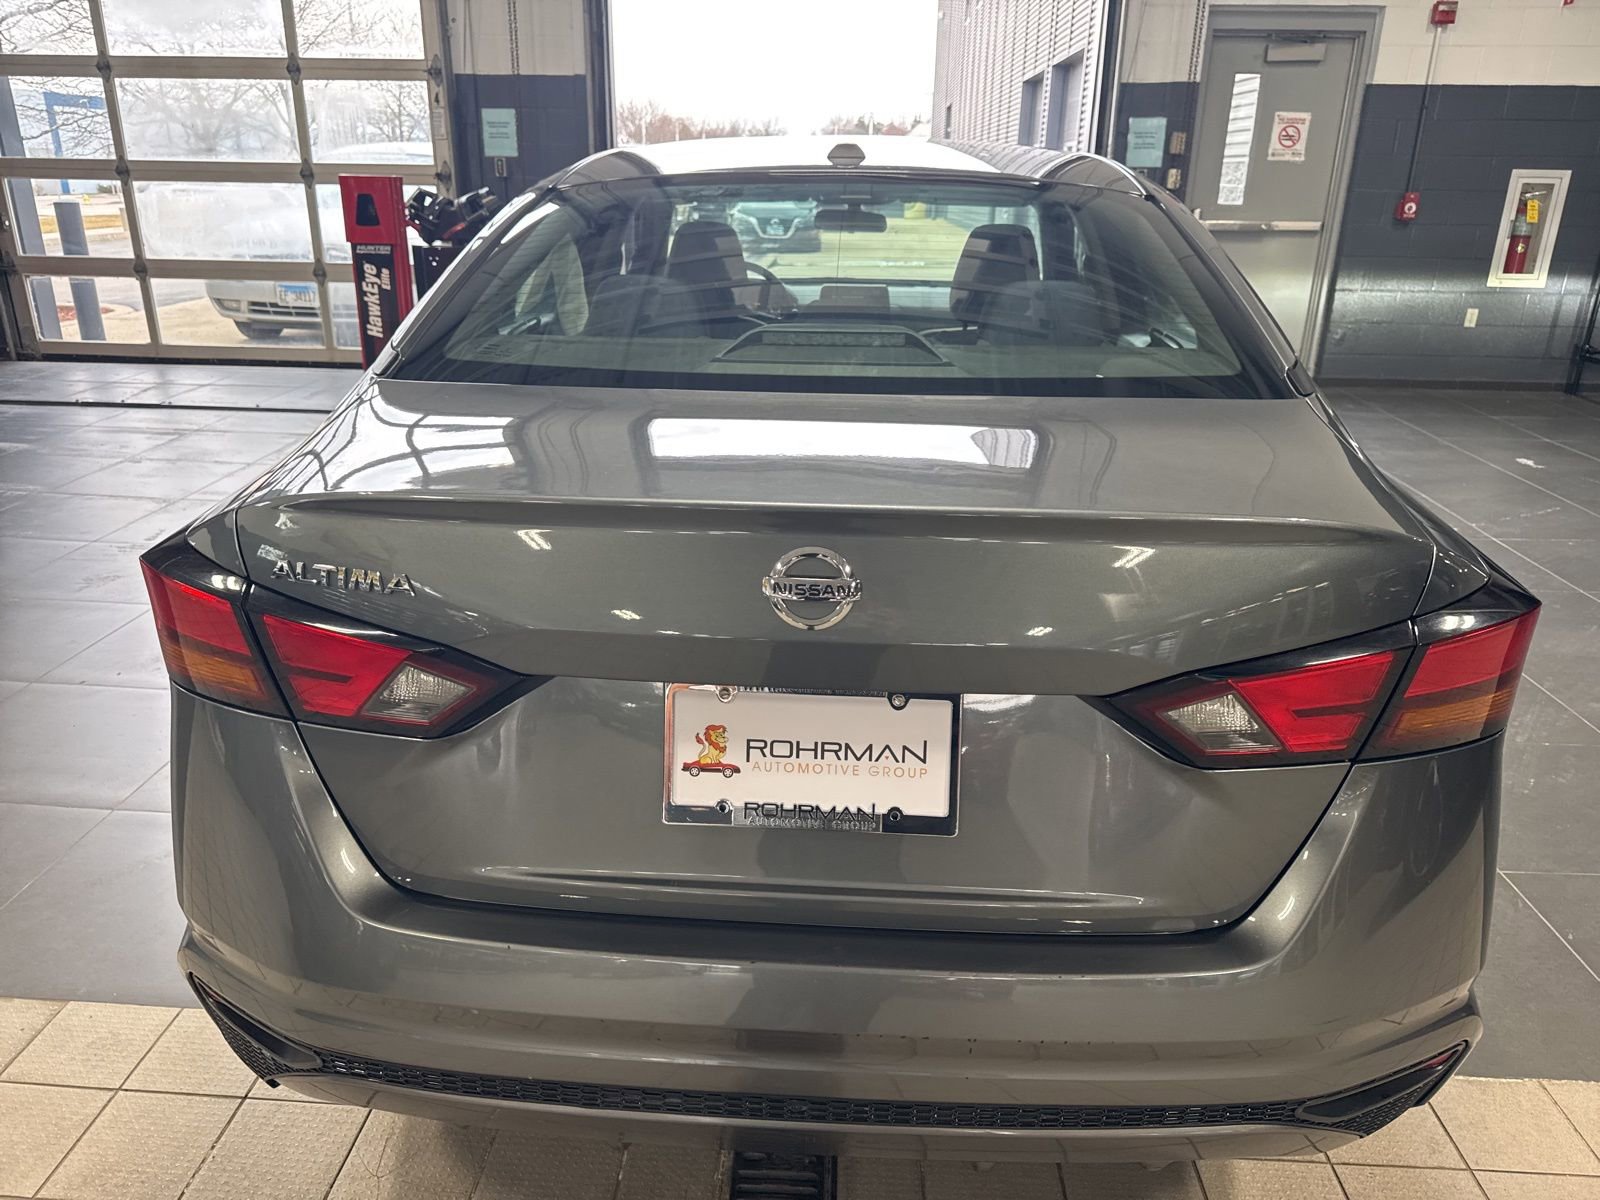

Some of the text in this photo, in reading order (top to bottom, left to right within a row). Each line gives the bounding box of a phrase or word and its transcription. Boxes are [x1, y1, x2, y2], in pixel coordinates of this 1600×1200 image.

[381, 267, 391, 291] Elite
[362, 263, 384, 339] HawkEye
[270, 559, 416, 597] ALTIMA
[773, 581, 852, 598] NISSAN
[746, 738, 928, 765] ROHRMAN
[751, 761, 928, 779] AUTOMOTIVE GROUP
[744, 802, 876, 821] ROHRMAN
[831, 820, 876, 832] GROUP
